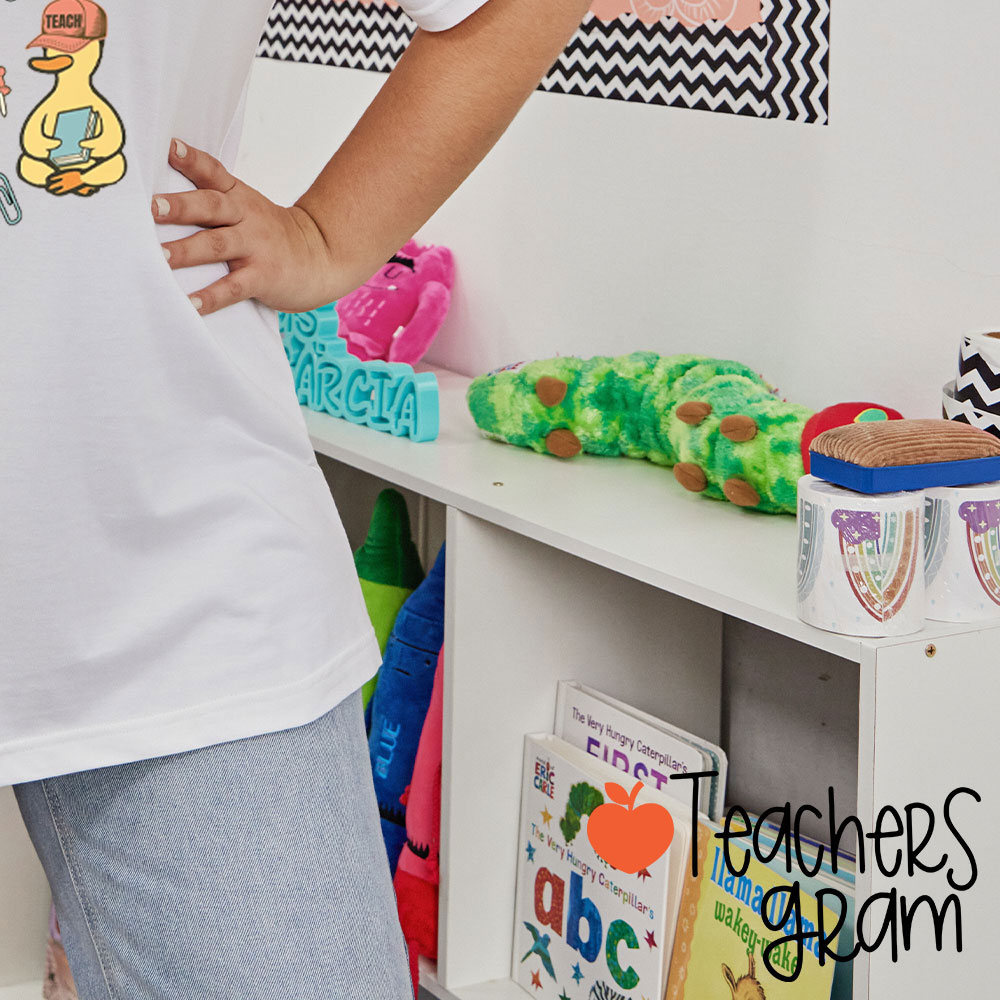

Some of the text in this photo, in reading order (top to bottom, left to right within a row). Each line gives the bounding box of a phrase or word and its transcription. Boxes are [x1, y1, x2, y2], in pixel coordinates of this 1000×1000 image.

[45, 12, 83, 30] TEACH
[286, 350, 419, 437] ARCIA
[375, 717, 402, 779] BLUE
[571, 706, 688, 775] The Very Hungry Caterpillar's
[533, 775, 555, 801] CARLE
[534, 761, 556, 786] ERIC
[531, 822, 655, 920] The Very Hungry Caterpillar's
[533, 866, 641, 990] abc
